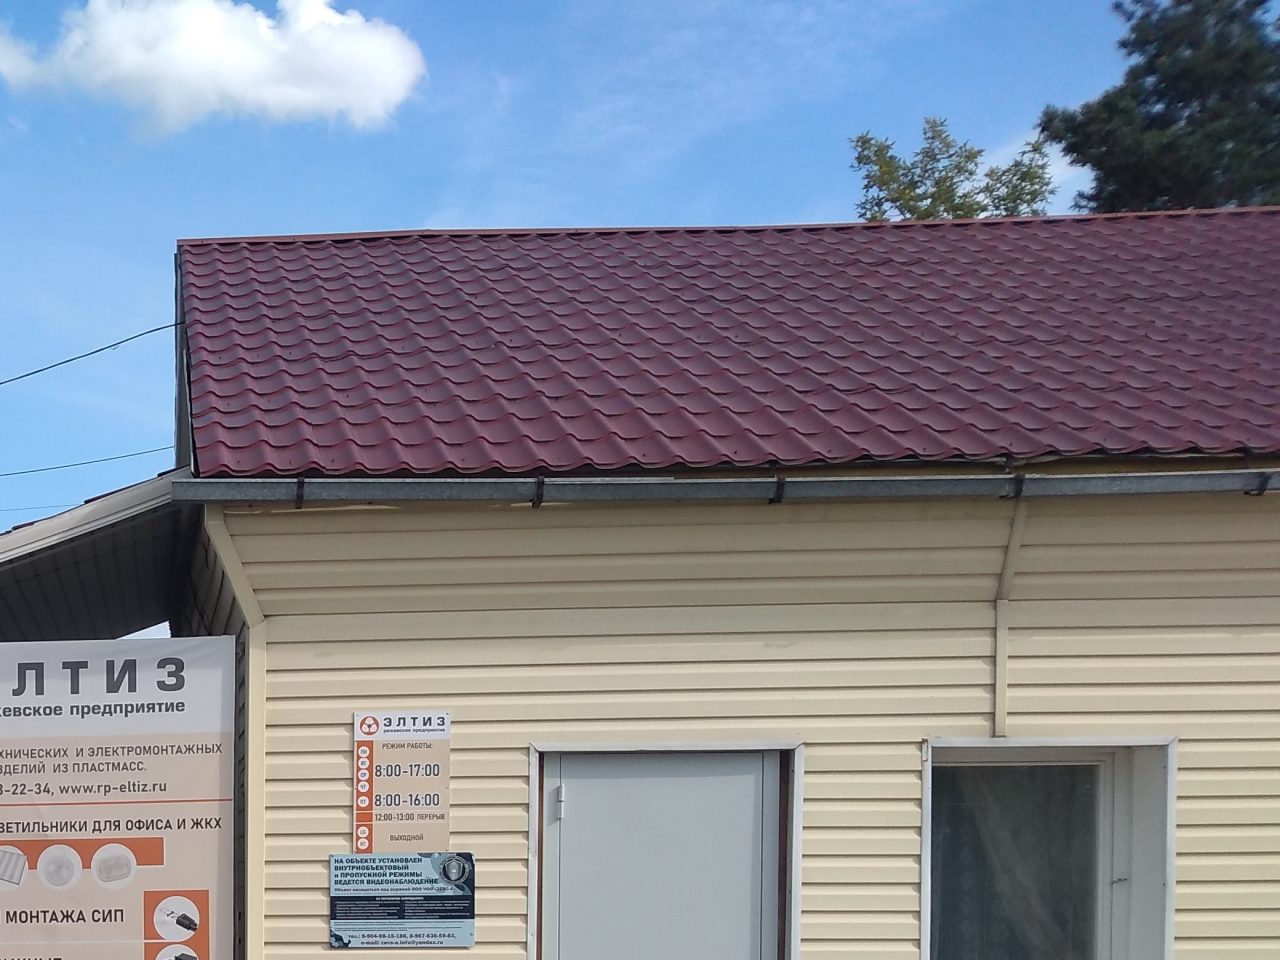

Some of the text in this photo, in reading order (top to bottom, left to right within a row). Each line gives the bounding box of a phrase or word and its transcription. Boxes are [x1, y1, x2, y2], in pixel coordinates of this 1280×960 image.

[70, 701, 186, 719] предприятие
[383, 716, 446, 727] ЭЛТИЗ
[75, 747, 84, 758] И
[87, 743, 222, 757] ЭЛЕКТРОМОНТАЖНЫХ
[53, 763, 69, 774] ИЗ
[72, 761, 147, 774] ПЛАСТМАСС.
[374, 764, 440, 777] 8:00-17:00
[58, 780, 167, 797] www.rp-eltiz.ru
[374, 793, 440, 807] 8:00-16:00
[374, 813, 415, 821] 12:00-13:00
[92, 819, 121, 834] ДЛЯ
[125, 818, 173, 831] ОФИСА
[177, 818, 186, 830] И
[190, 817, 222, 830] ЖКХ
[366, 877, 439, 886] ВИДЕОНАБЛЮДЕНИЕ
[5, 909, 87, 924] МОНТАЖА
[91, 909, 124, 923] СИП
